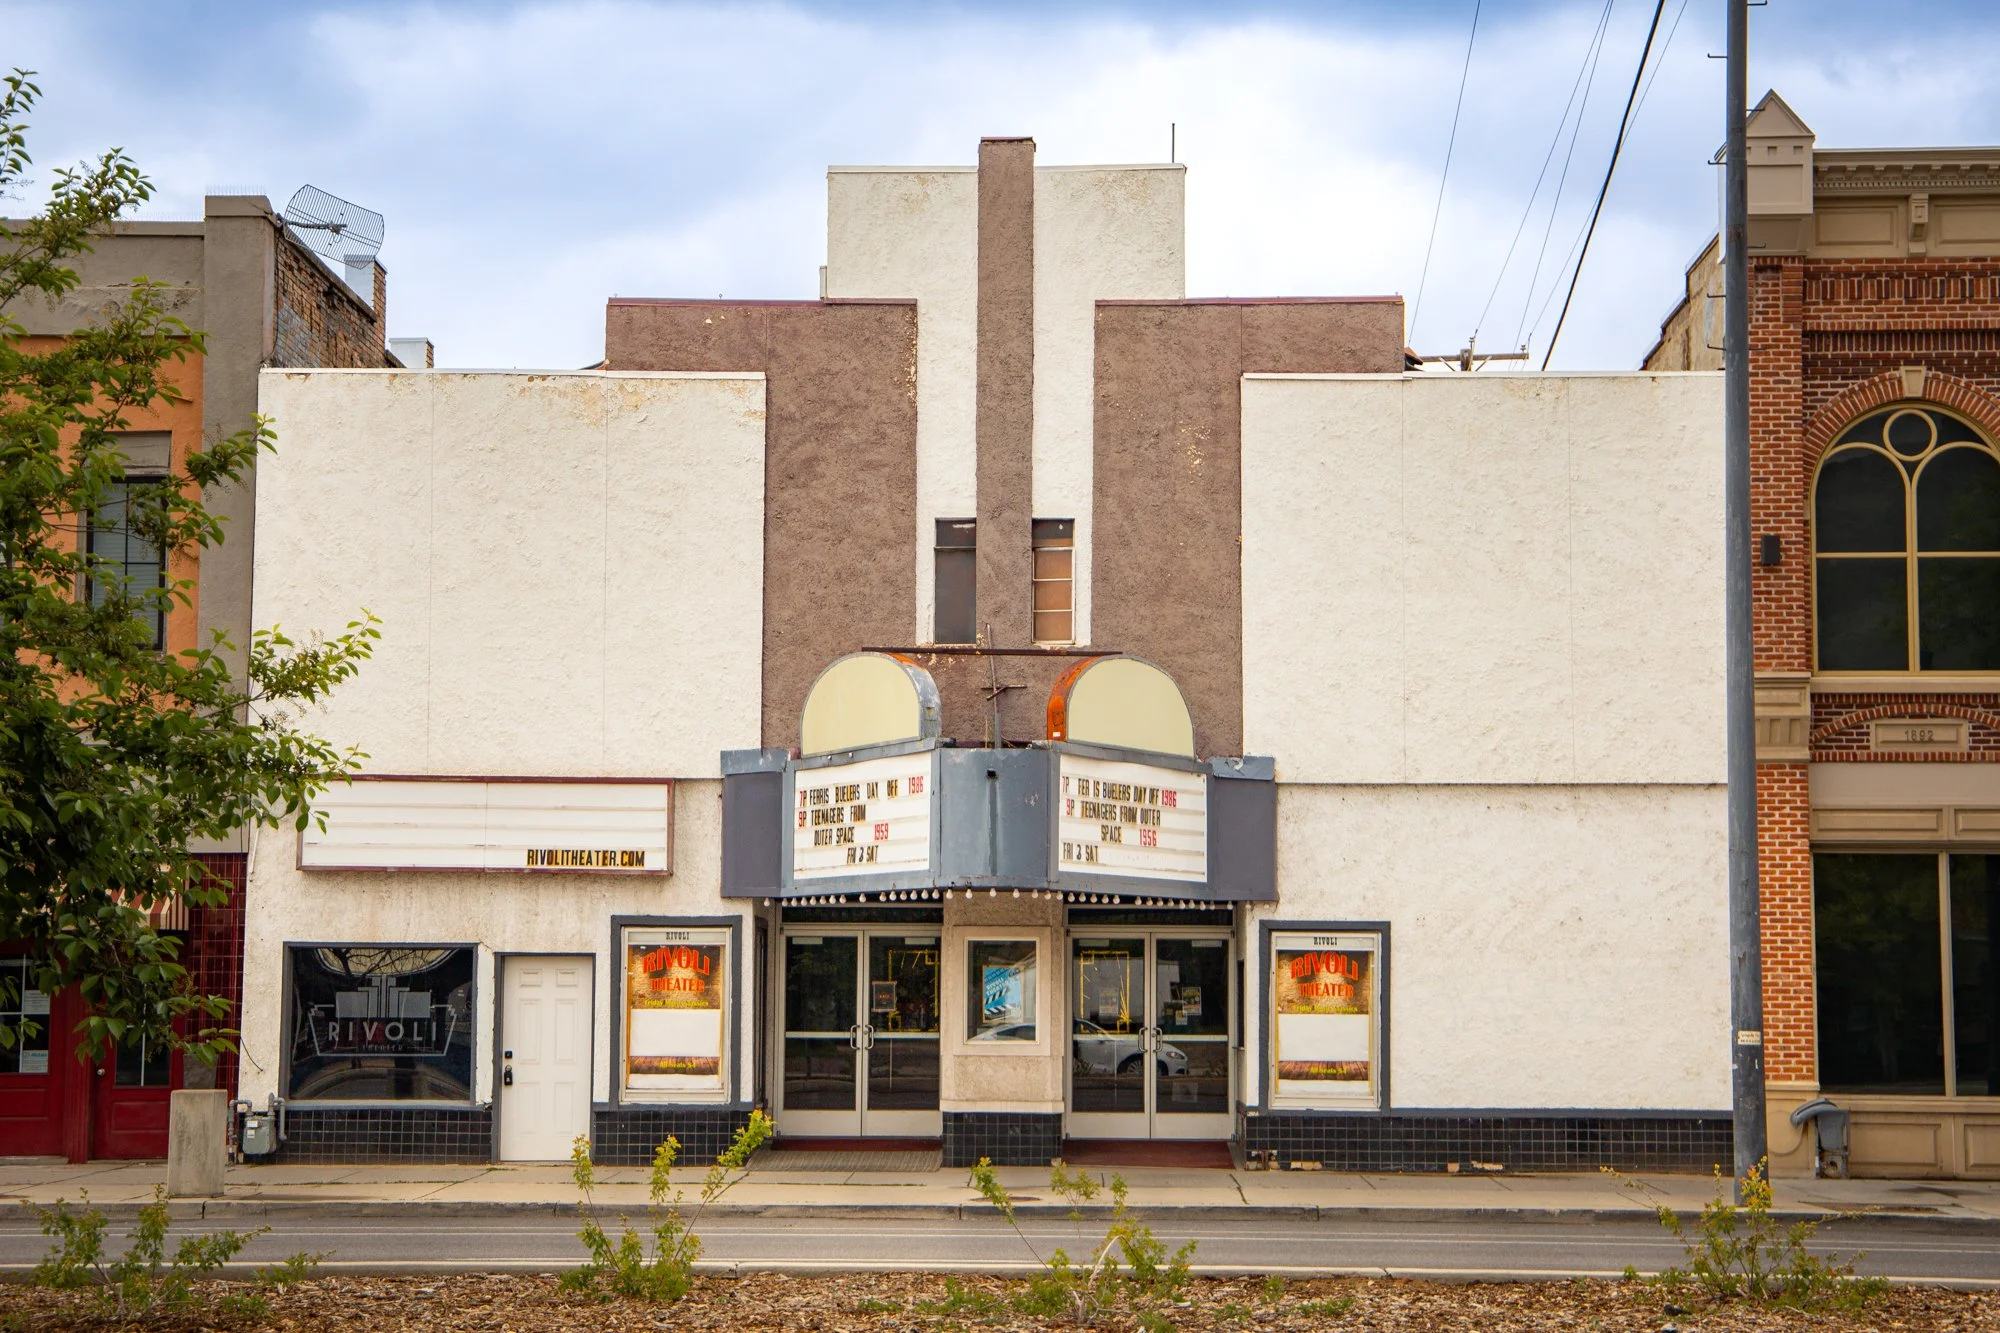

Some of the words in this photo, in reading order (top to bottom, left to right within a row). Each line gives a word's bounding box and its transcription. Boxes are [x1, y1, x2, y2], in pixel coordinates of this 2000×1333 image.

[1904, 729, 1934, 743] 1892
[809, 788, 829, 805] FERRIS
[835, 784, 860, 803] BUELERS
[866, 782, 879, 799] DAY
[887, 779, 899, 797] OFF
[908, 776, 923, 794] 1986
[1103, 782, 1131, 801] BUELERS
[1134, 786, 1147, 803] DAY
[1149, 788, 1160, 805] OFF
[1161, 789, 1177, 807] 1986
[799, 811, 807, 827] 9P
[811, 807, 844, 825] TEENAGERS
[851, 805, 866, 822] FROM
[1066, 799, 1075, 816] 9P
[1081, 801, 1117, 821] TEENAGERS
[1120, 806, 1137, 823] FROM
[1140, 808, 1160, 826] OUTER
[814, 829, 833, 846] OUTER
[836, 827, 855, 844] SPACE
[875, 823, 888, 840] 1959
[1101, 825, 1122, 842] SPACE
[527, 849, 645, 867] RIVOLITHEATER.COM
[847, 847, 857, 864] FRI
[866, 845, 879, 861] SAT
[1063, 842, 1074, 860] FRI
[1085, 845, 1098, 862] SAT
[665, 931, 690, 940] RIVOLI
[1314, 936, 1338, 945] RIVOLI
[642, 946, 710, 976] RIVOLI
[1290, 952, 1358, 981] RIVOLI
[650, 977, 705, 993] THEATER
[1298, 982, 1354, 998] THEATER
[328, 1021, 437, 1041] RIVOLI
